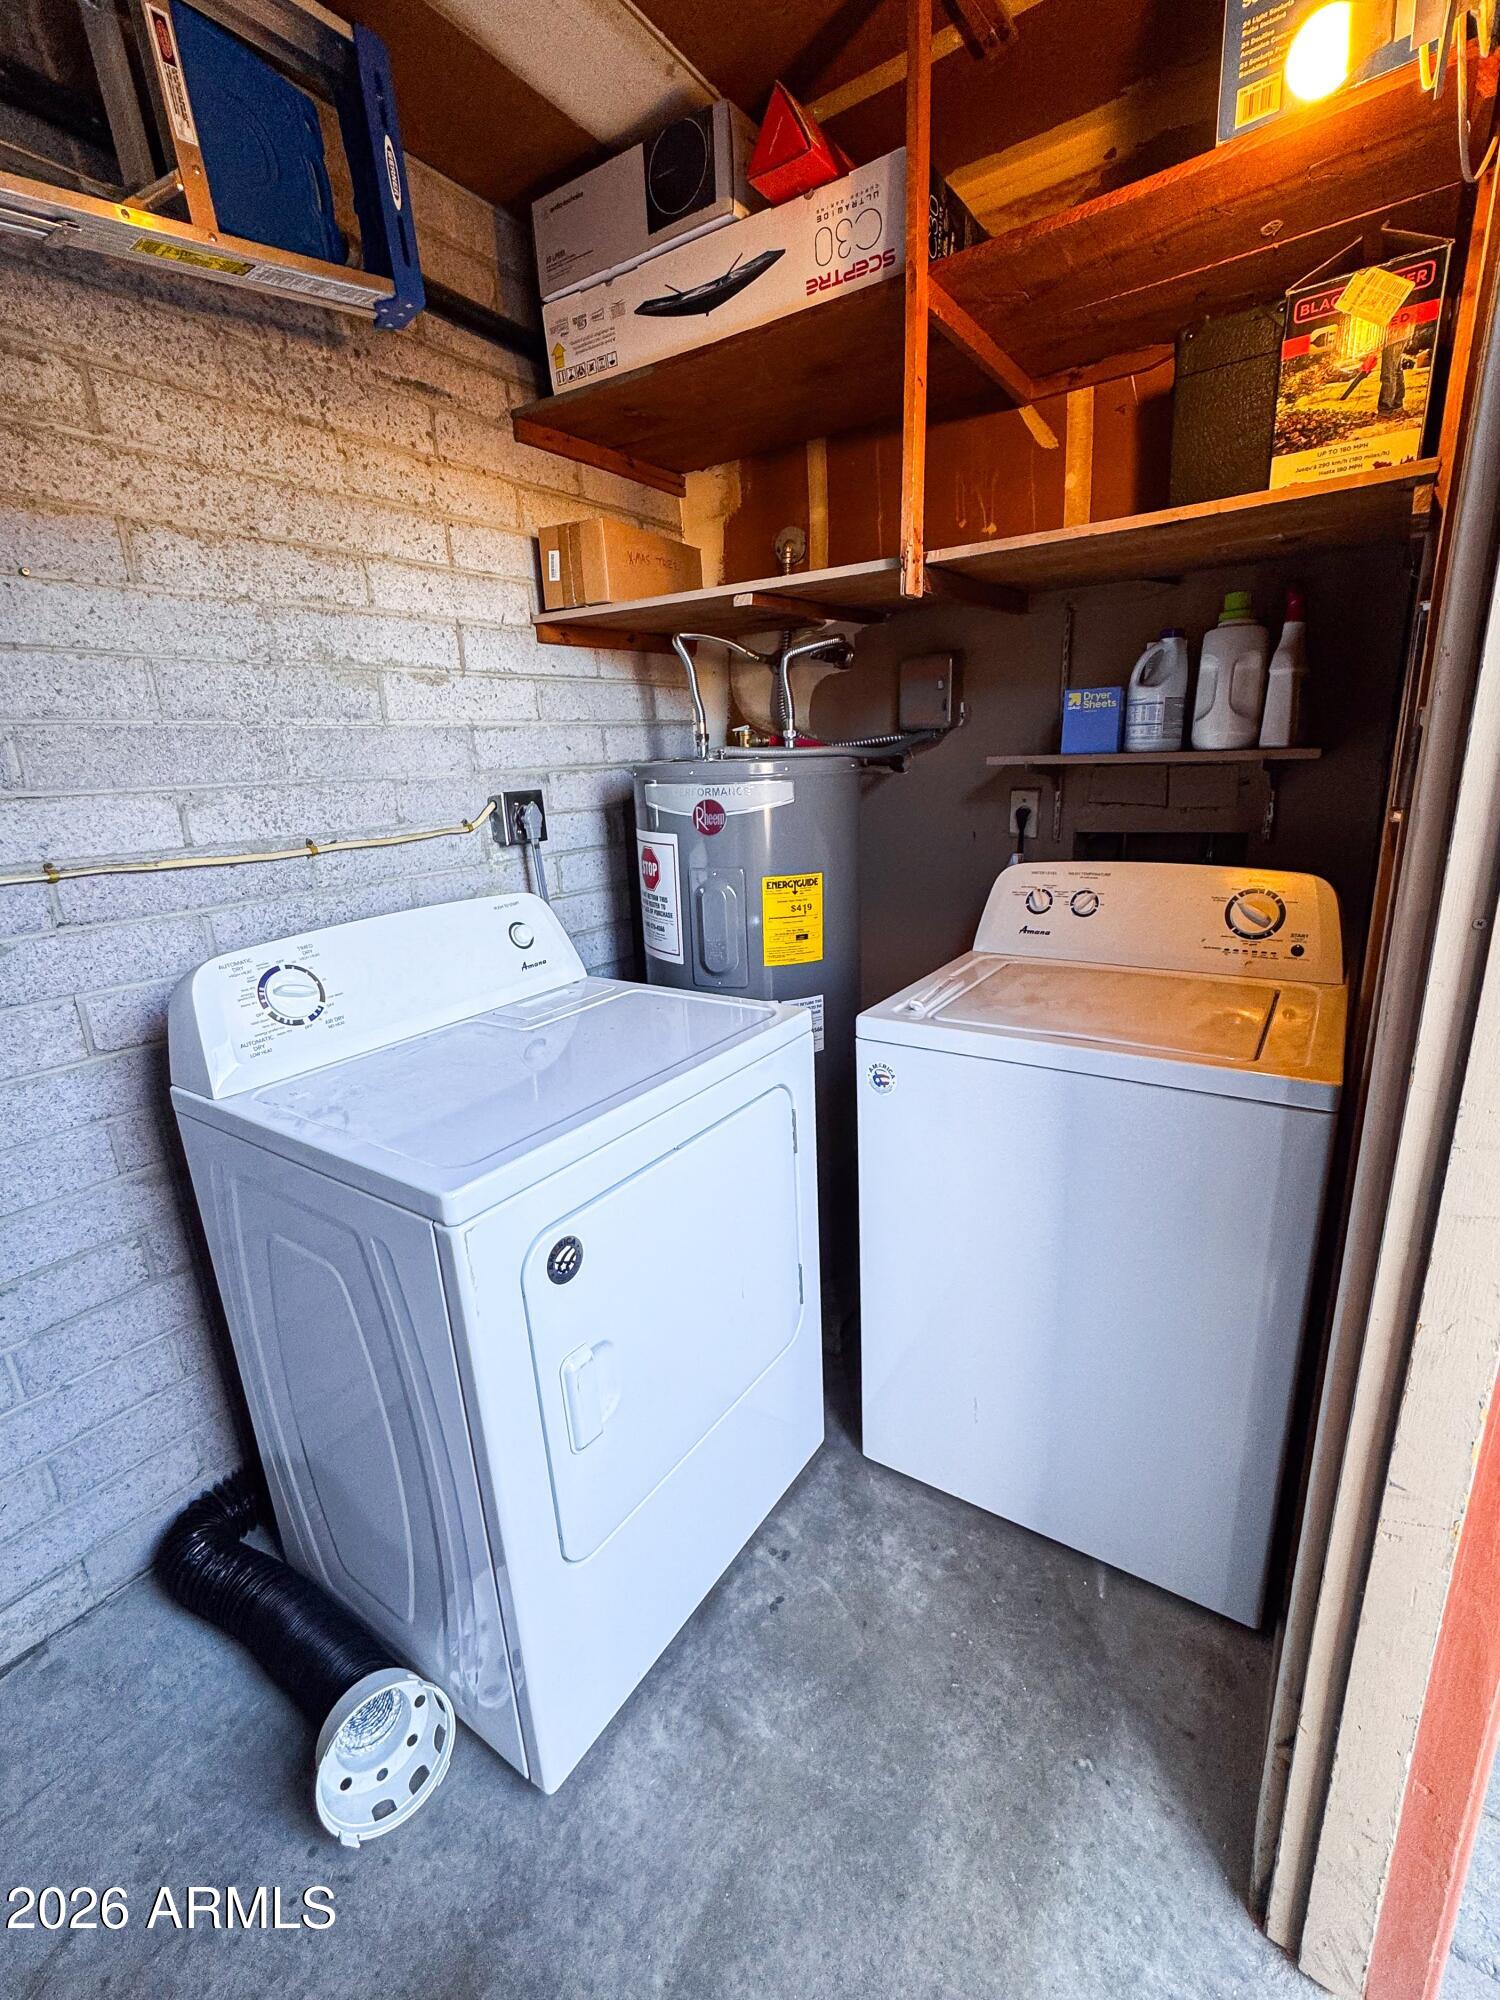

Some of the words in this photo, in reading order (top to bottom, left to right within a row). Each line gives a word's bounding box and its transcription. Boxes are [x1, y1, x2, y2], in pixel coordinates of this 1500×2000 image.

[816, 189, 880, 224] ULTRAWIDE
[814, 207, 883, 267] C30
[805, 247, 897, 297] SCEPTRE
[1316, 450, 1327, 458] UP
[1353, 442, 1369, 451] MPH
[627, 551, 651, 566] X-MAS
[1083, 691, 1112, 701] Dryer
[1083, 699, 1117, 709] Sheets
[695, 798, 726, 832] Rheem
[641, 860, 658, 877] STOP
[766, 877, 819, 892] ENERGYGUIDE
[790, 903, 813, 914] $419
[1018, 925, 1052, 936] Amana
[218, 958, 254, 970] AUTOMATIC
[521, 959, 548, 972] Amana
[240, 1035, 275, 1050] AUTOMATIC
[252, 1044, 266, 1052] DRY
[868, 1062, 896, 1080] AMERICA
